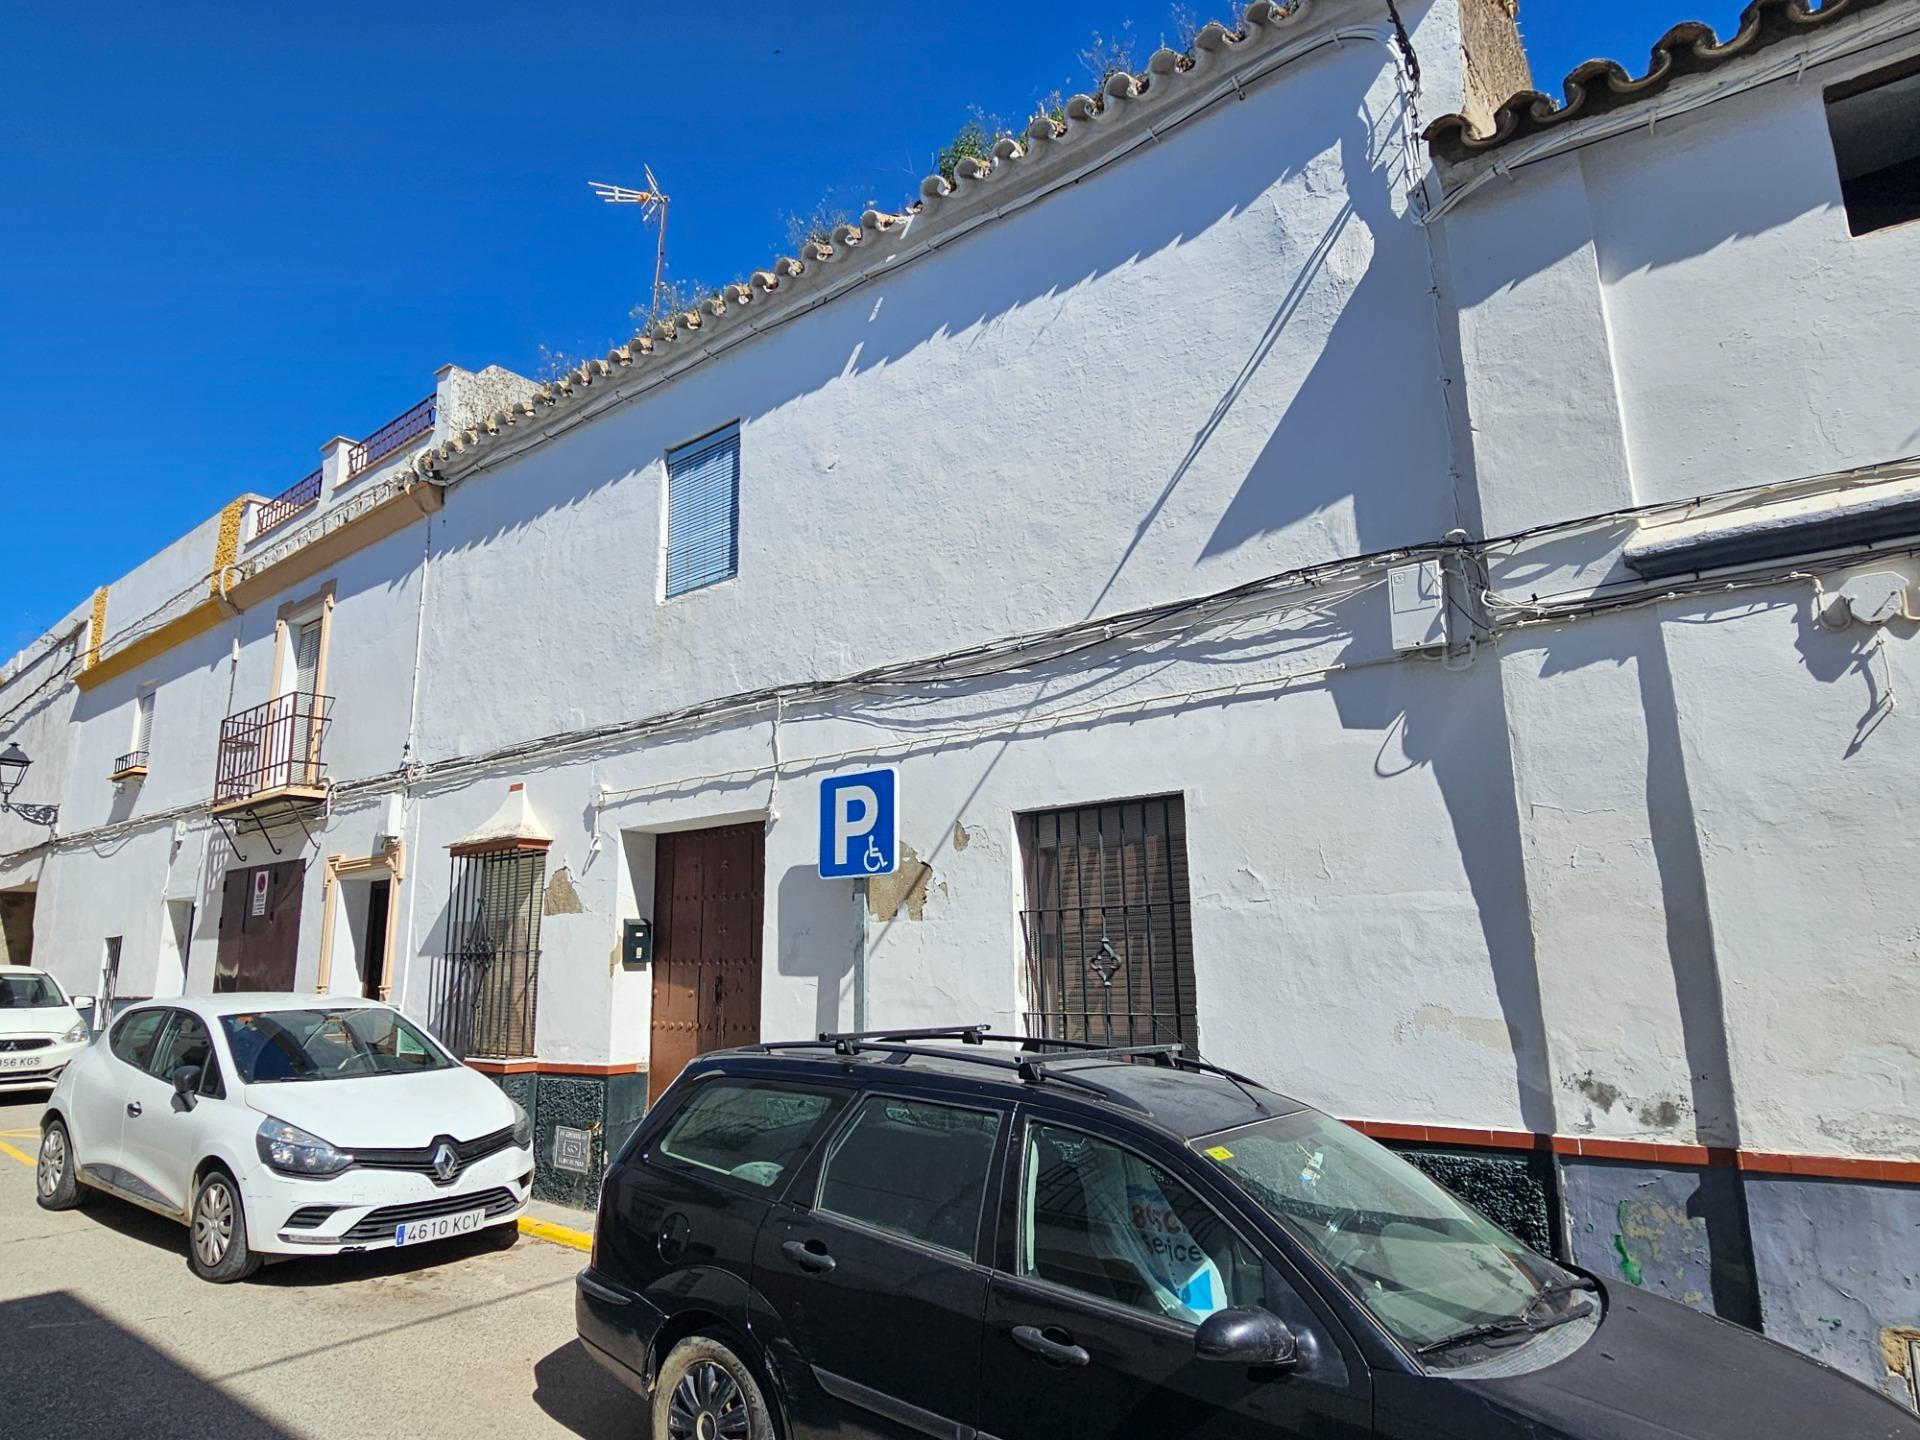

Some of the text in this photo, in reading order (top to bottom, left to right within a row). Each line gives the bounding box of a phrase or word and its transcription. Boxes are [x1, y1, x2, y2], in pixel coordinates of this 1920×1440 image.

[834, 785, 878, 865] P
[20, 1056, 41, 1066] KGS
[408, 1211, 481, 1241] 4610 KCV
